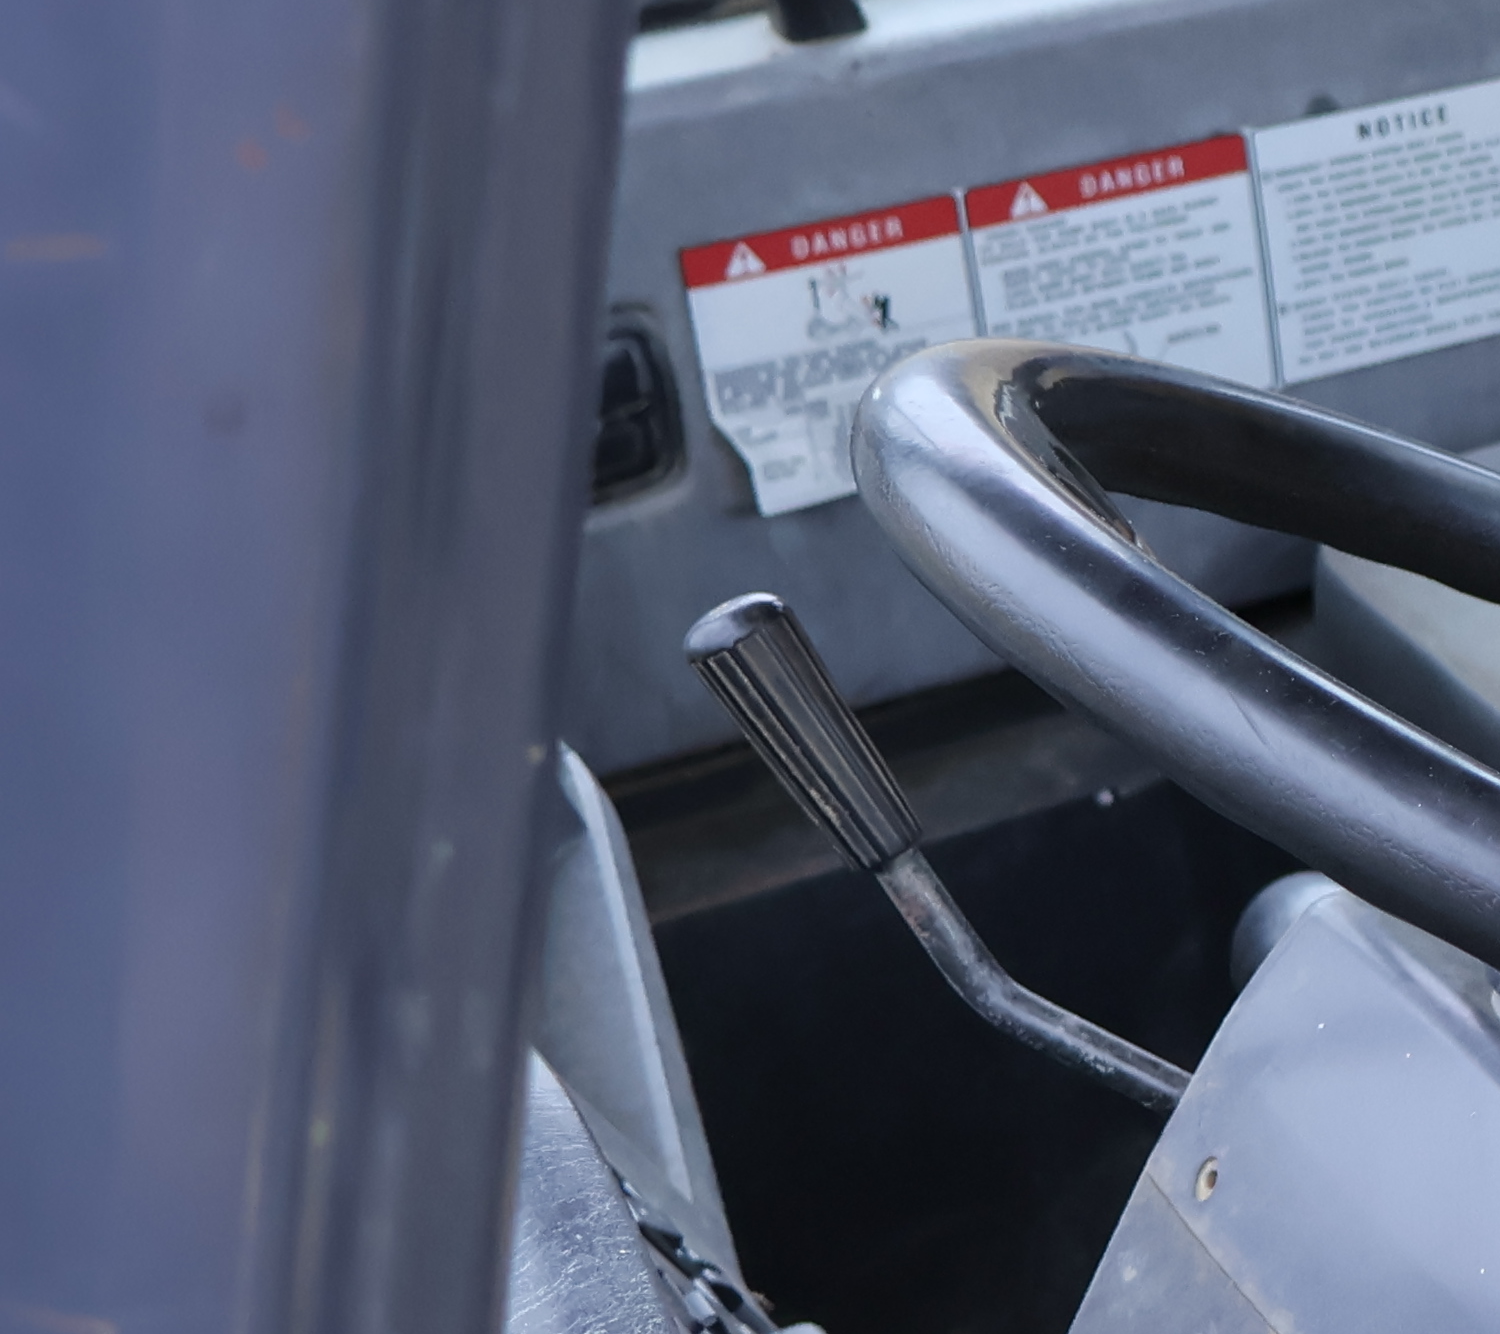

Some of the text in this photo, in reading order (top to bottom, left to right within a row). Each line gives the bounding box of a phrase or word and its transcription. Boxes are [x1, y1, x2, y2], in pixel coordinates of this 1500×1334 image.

[1355, 103, 1449, 141] NOTICE
[1077, 153, 1185, 199] DANGER
[790, 216, 904, 260] DANGER
